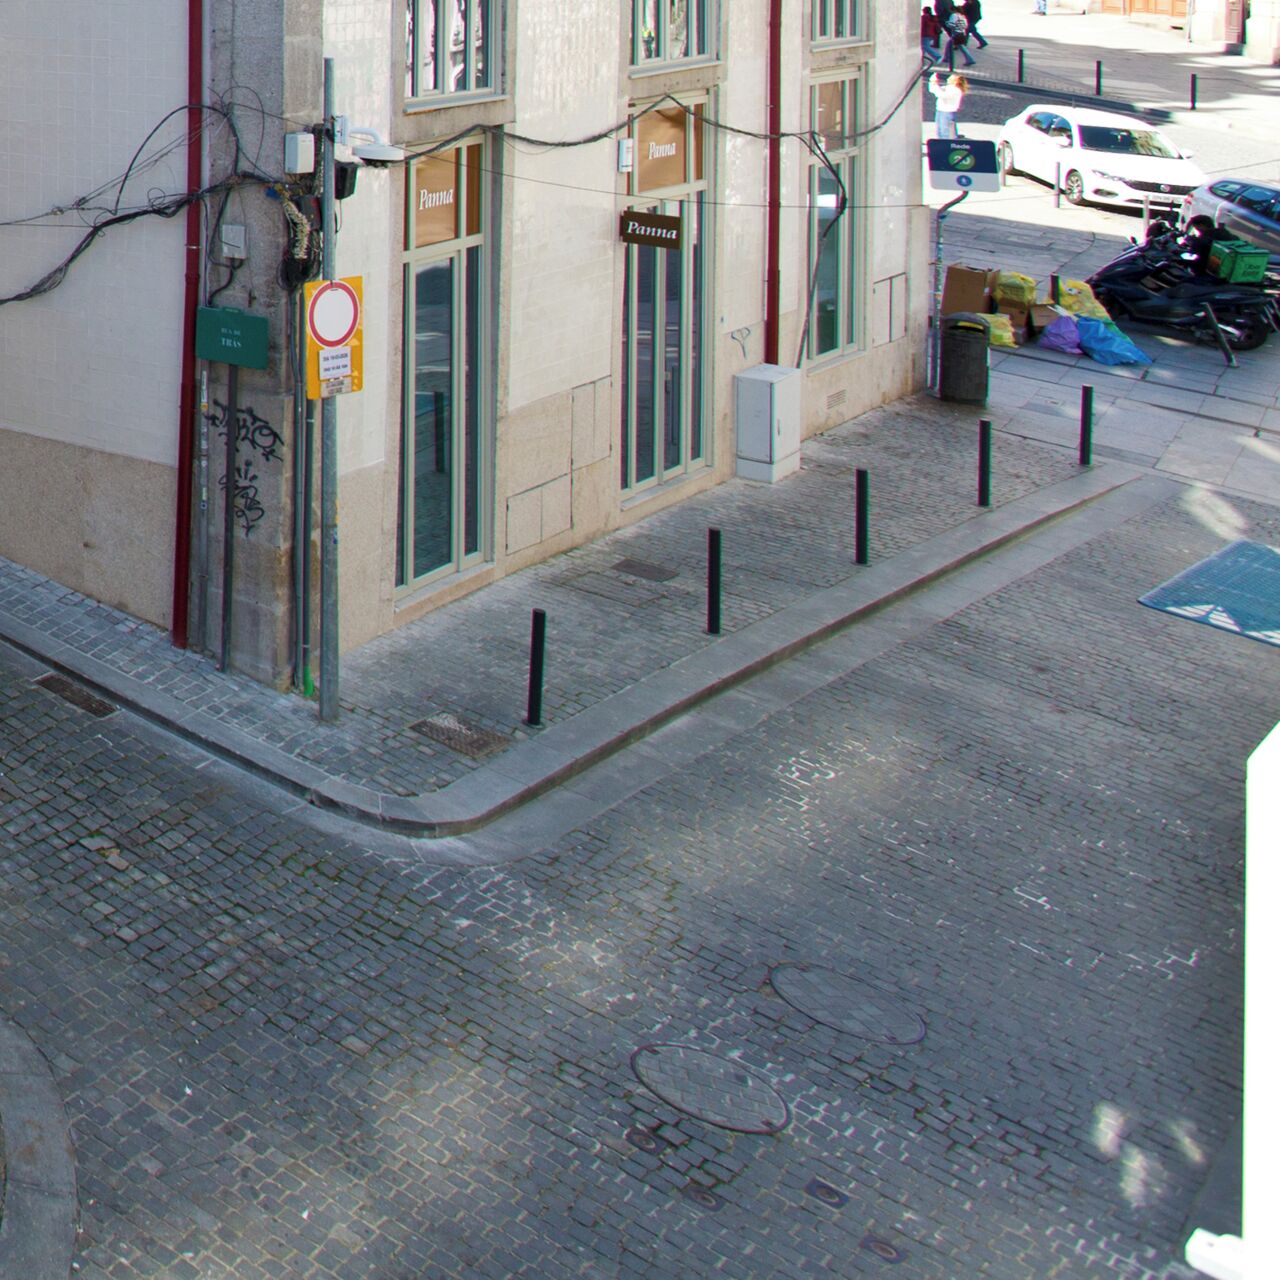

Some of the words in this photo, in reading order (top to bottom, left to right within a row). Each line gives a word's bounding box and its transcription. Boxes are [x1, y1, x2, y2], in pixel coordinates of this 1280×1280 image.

[648, 141, 677, 160] Panna
[418, 187, 455, 210] Panna
[627, 221, 678, 239] Panna
